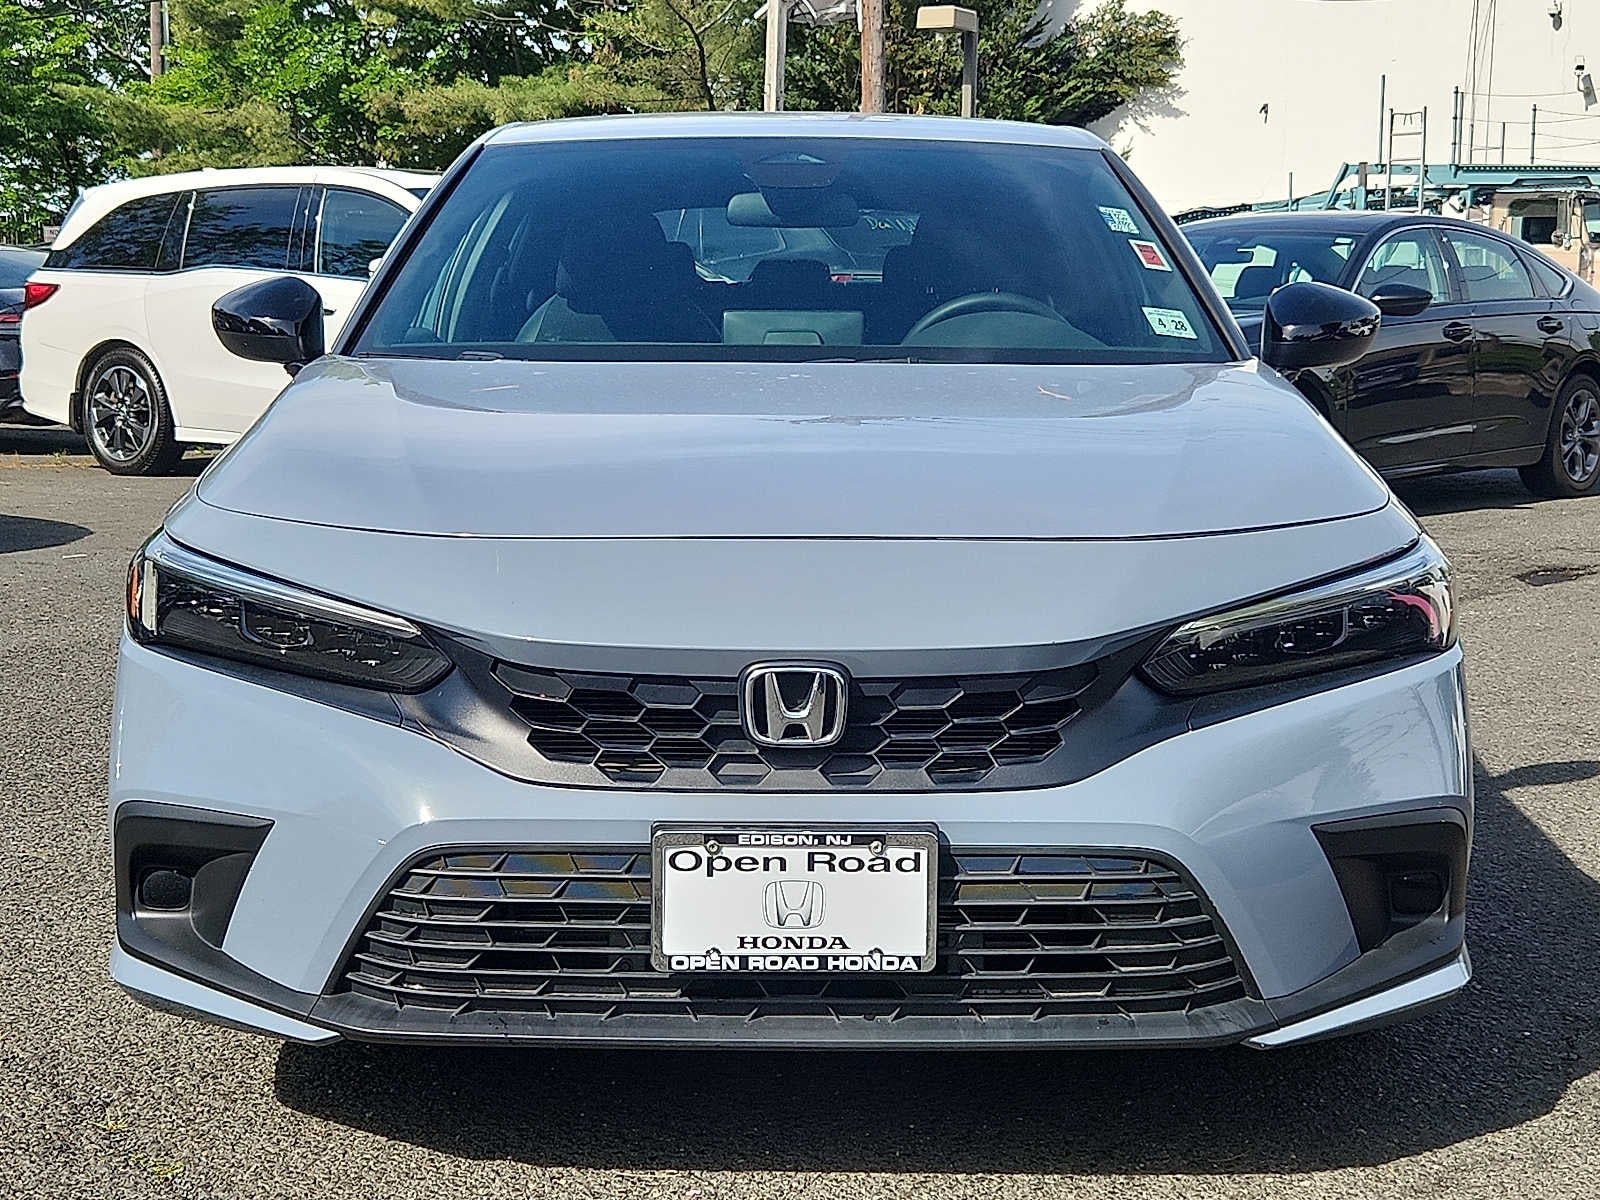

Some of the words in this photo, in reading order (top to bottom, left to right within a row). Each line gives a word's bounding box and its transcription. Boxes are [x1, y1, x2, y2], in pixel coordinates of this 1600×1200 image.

[1158, 318, 1167, 329] 4
[1171, 319, 1188, 332] 28
[738, 834, 819, 846] EDISON,
[825, 835, 852, 846] NJ
[668, 850, 787, 878] Open
[807, 851, 921, 873] Road
[736, 935, 852, 950] HONDA
[670, 955, 740, 971] OPEN
[748, 955, 819, 971] ROAD
[827, 956, 919, 971] HONDA
